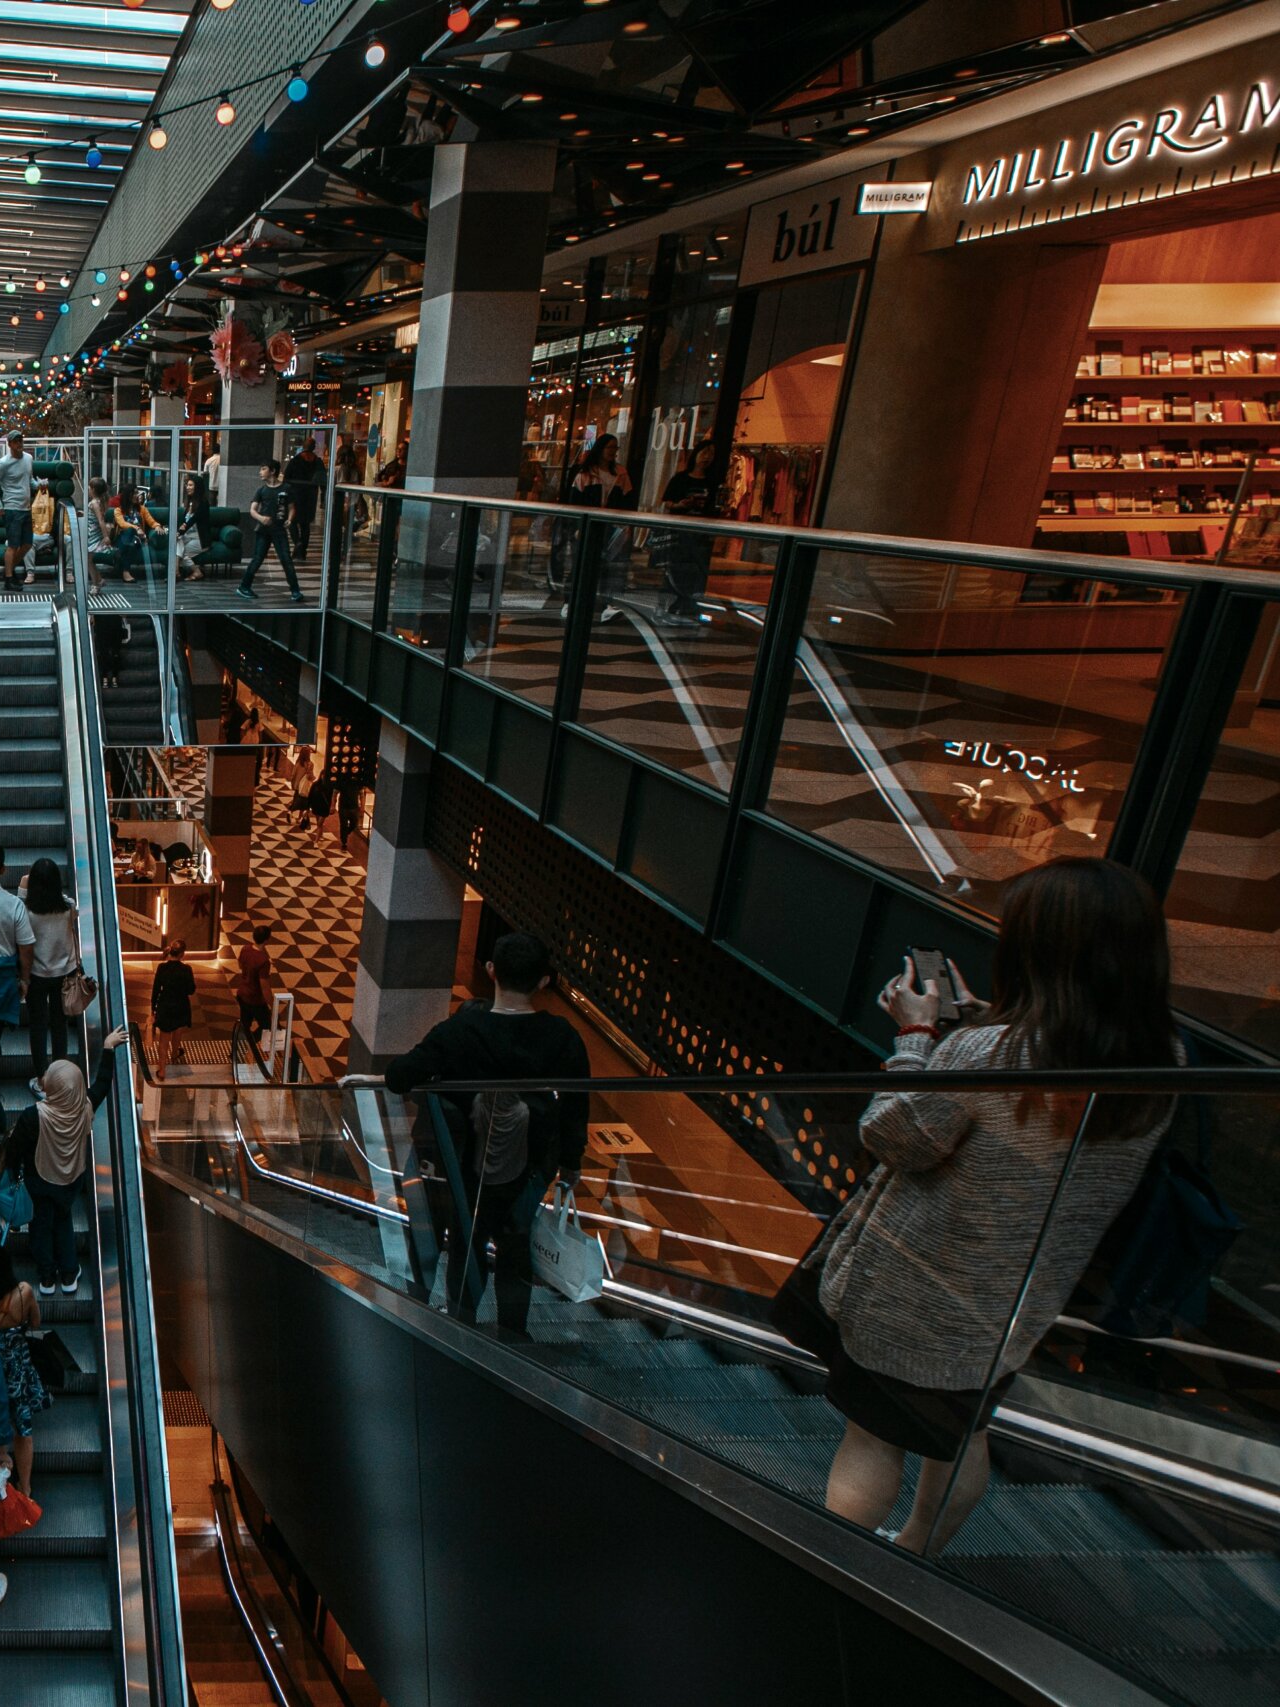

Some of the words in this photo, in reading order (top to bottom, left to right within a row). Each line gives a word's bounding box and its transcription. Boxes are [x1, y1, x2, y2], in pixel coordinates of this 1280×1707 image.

[962, 78, 1280, 206] MILLIGRAM
[865, 192, 925, 203] MILLIGRAM
[772, 196, 841, 264] búl
[540, 303, 570, 323] búl
[650, 404, 700, 451] búl
[533, 1240, 560, 1265] seed
